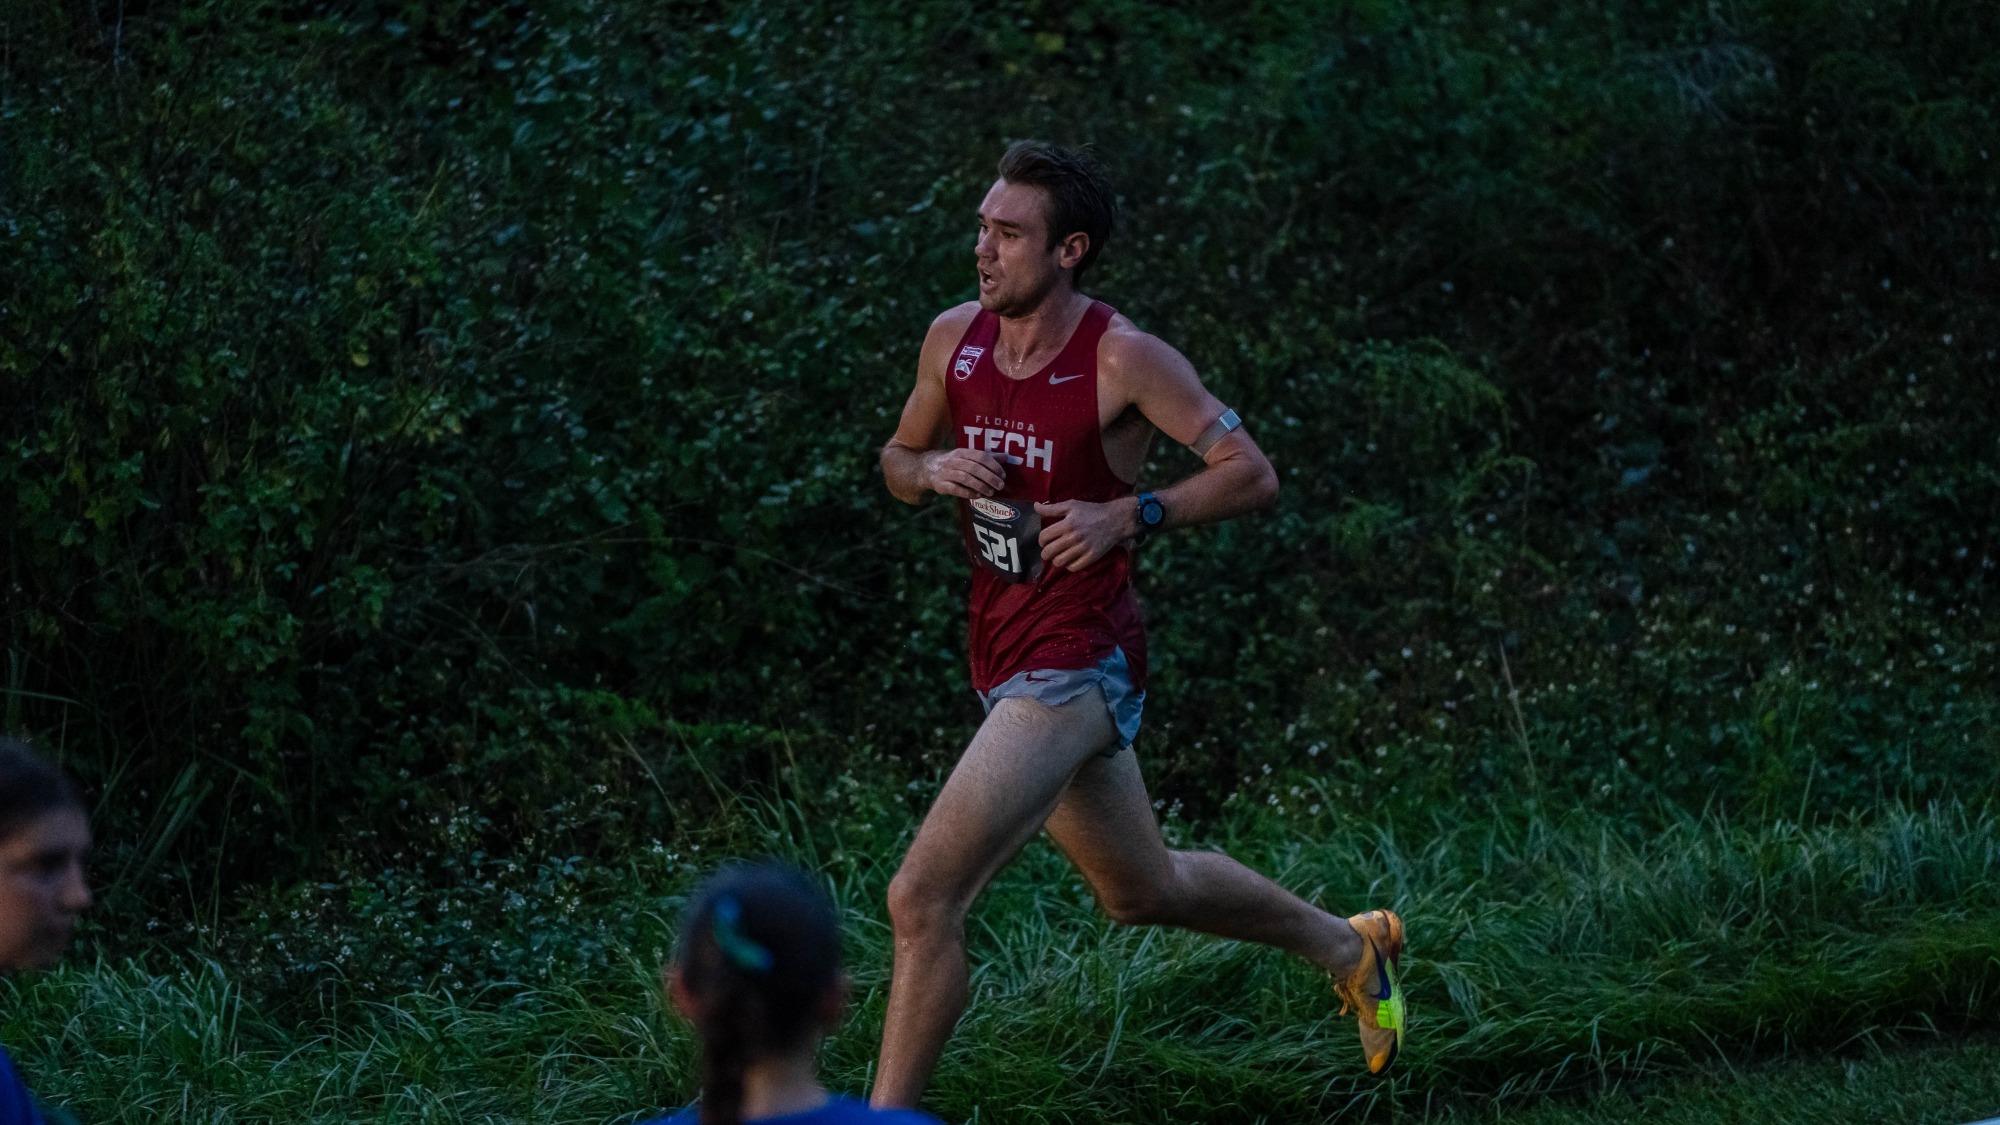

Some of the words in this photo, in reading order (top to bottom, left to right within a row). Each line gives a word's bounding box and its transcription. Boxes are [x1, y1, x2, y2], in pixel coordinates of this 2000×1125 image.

[975, 415, 1035, 433] FLORIDA
[963, 425, 1054, 473] TECH
[973, 522, 1023, 573] 521
